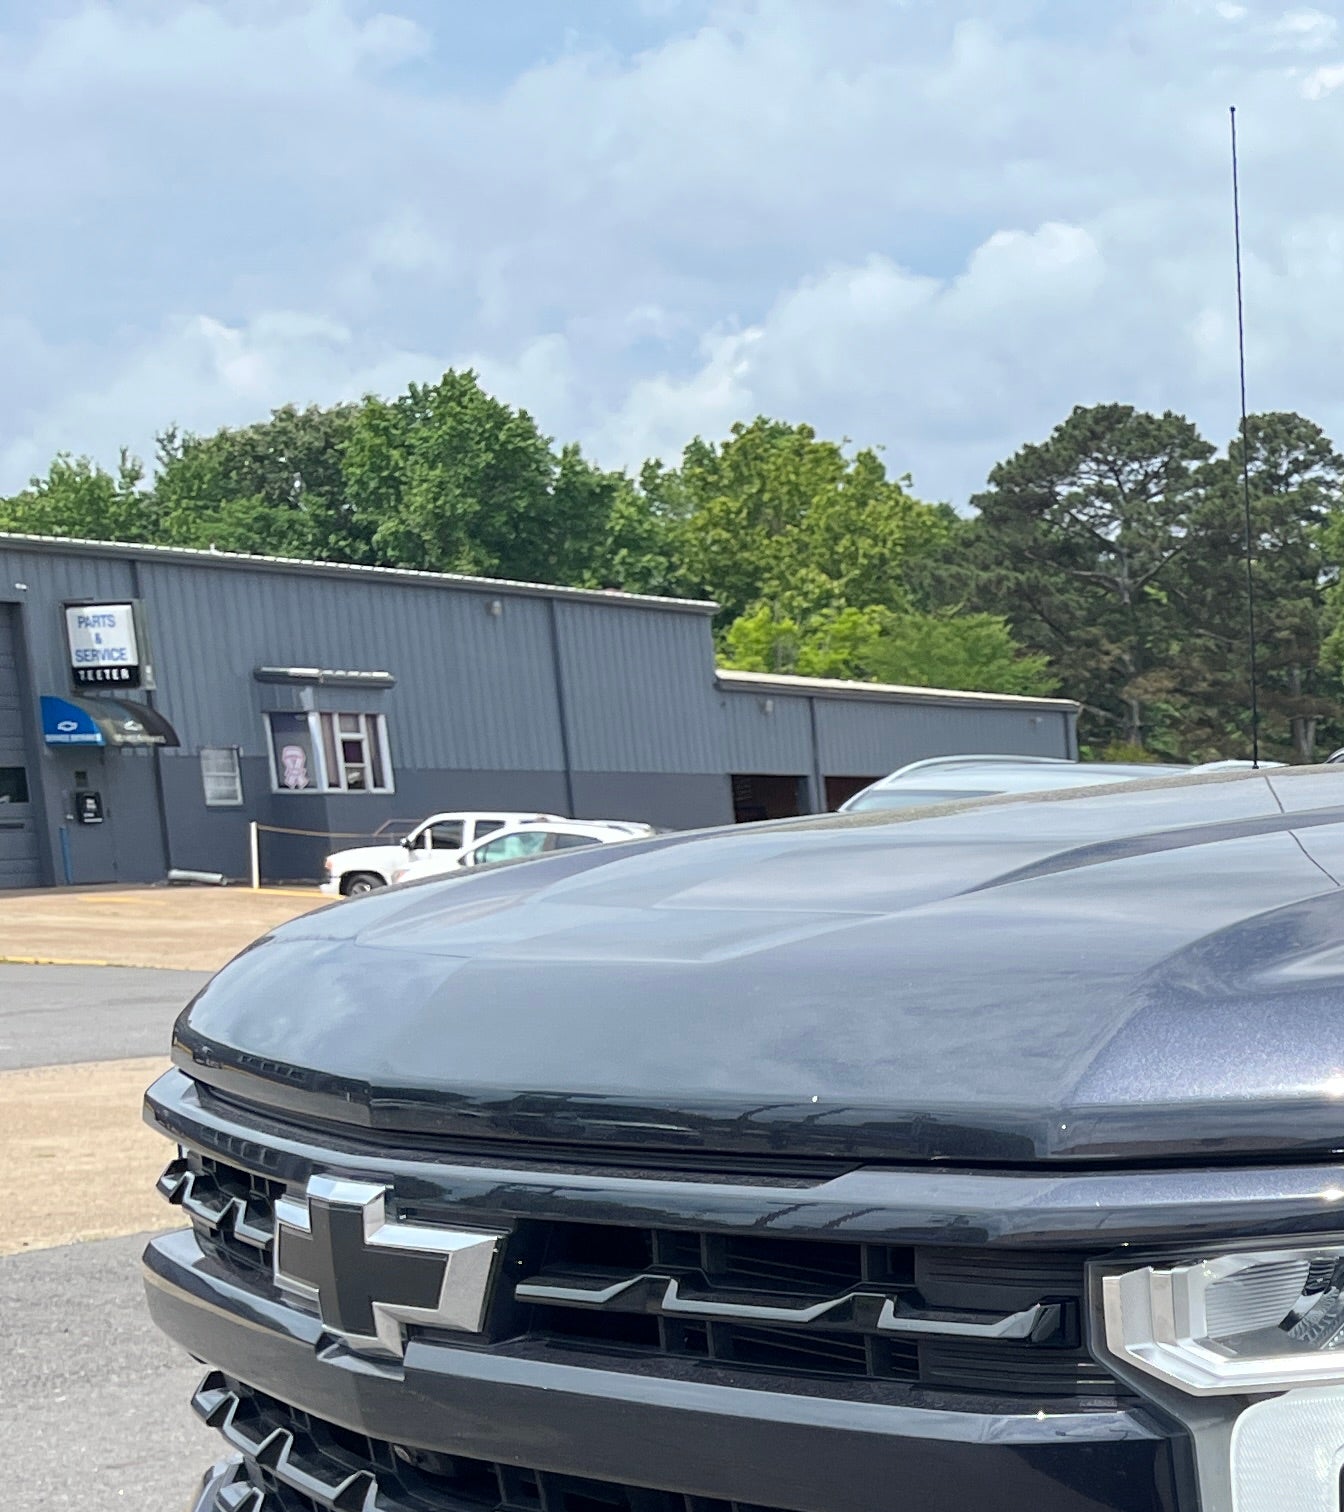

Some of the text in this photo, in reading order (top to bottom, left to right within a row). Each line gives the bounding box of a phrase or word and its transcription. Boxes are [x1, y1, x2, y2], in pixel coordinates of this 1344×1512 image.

[77, 614, 116, 628] PARTS
[95, 632, 102, 645] &
[75, 648, 128, 662] SERVICE
[78, 668, 130, 681] TEETER
